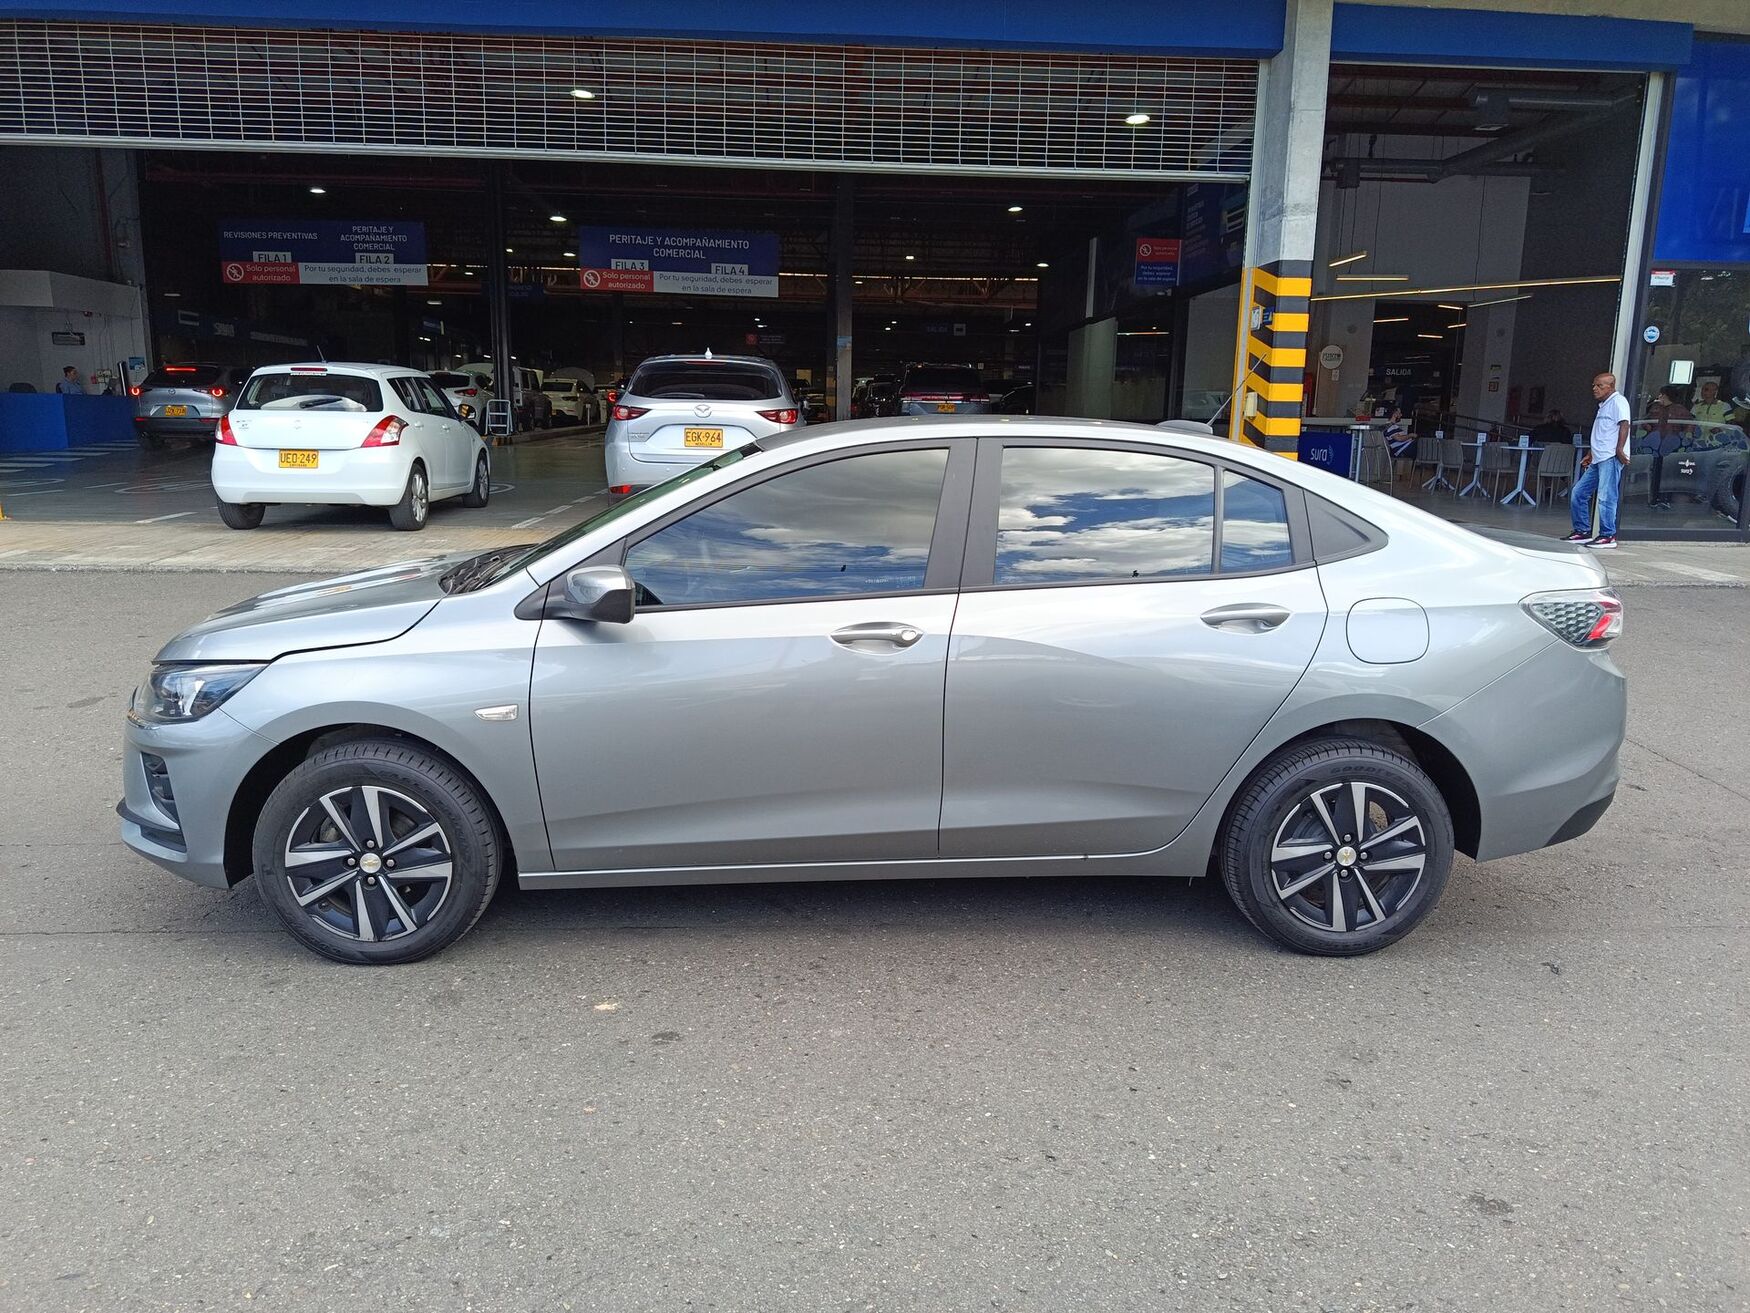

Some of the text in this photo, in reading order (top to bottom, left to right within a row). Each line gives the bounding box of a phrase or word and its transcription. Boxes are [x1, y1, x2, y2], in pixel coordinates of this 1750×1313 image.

[352, 225, 394, 234] PERITAJE Y
[223, 231, 318, 240] REVISIONES PREVENTIVAS
[609, 234, 750, 249] PERITAJE Y ACOMPAÑAMIENTO
[353, 243, 396, 251] COMERCIAL
[258, 253, 281, 263] FILA
[653, 248, 706, 259] COMERCIAL
[360, 254, 390, 264] FILA 2
[264, 265, 296, 274] personal
[304, 264, 317, 272] Por
[394, 267, 422, 275] esperar
[615, 261, 645, 270] FILA 3
[715, 265, 745, 275] FILA 4
[340, 275, 347, 283] la
[375, 277, 401, 285] espera
[602, 271, 651, 281] Solo personal
[659, 273, 670, 281] Por
[745, 278, 773, 286] esperar
[700, 285, 715, 293] sala
[727, 287, 752, 295] espera
[1385, 368, 1411, 376] SALIDA
[1310, 448, 1328, 462] sura
